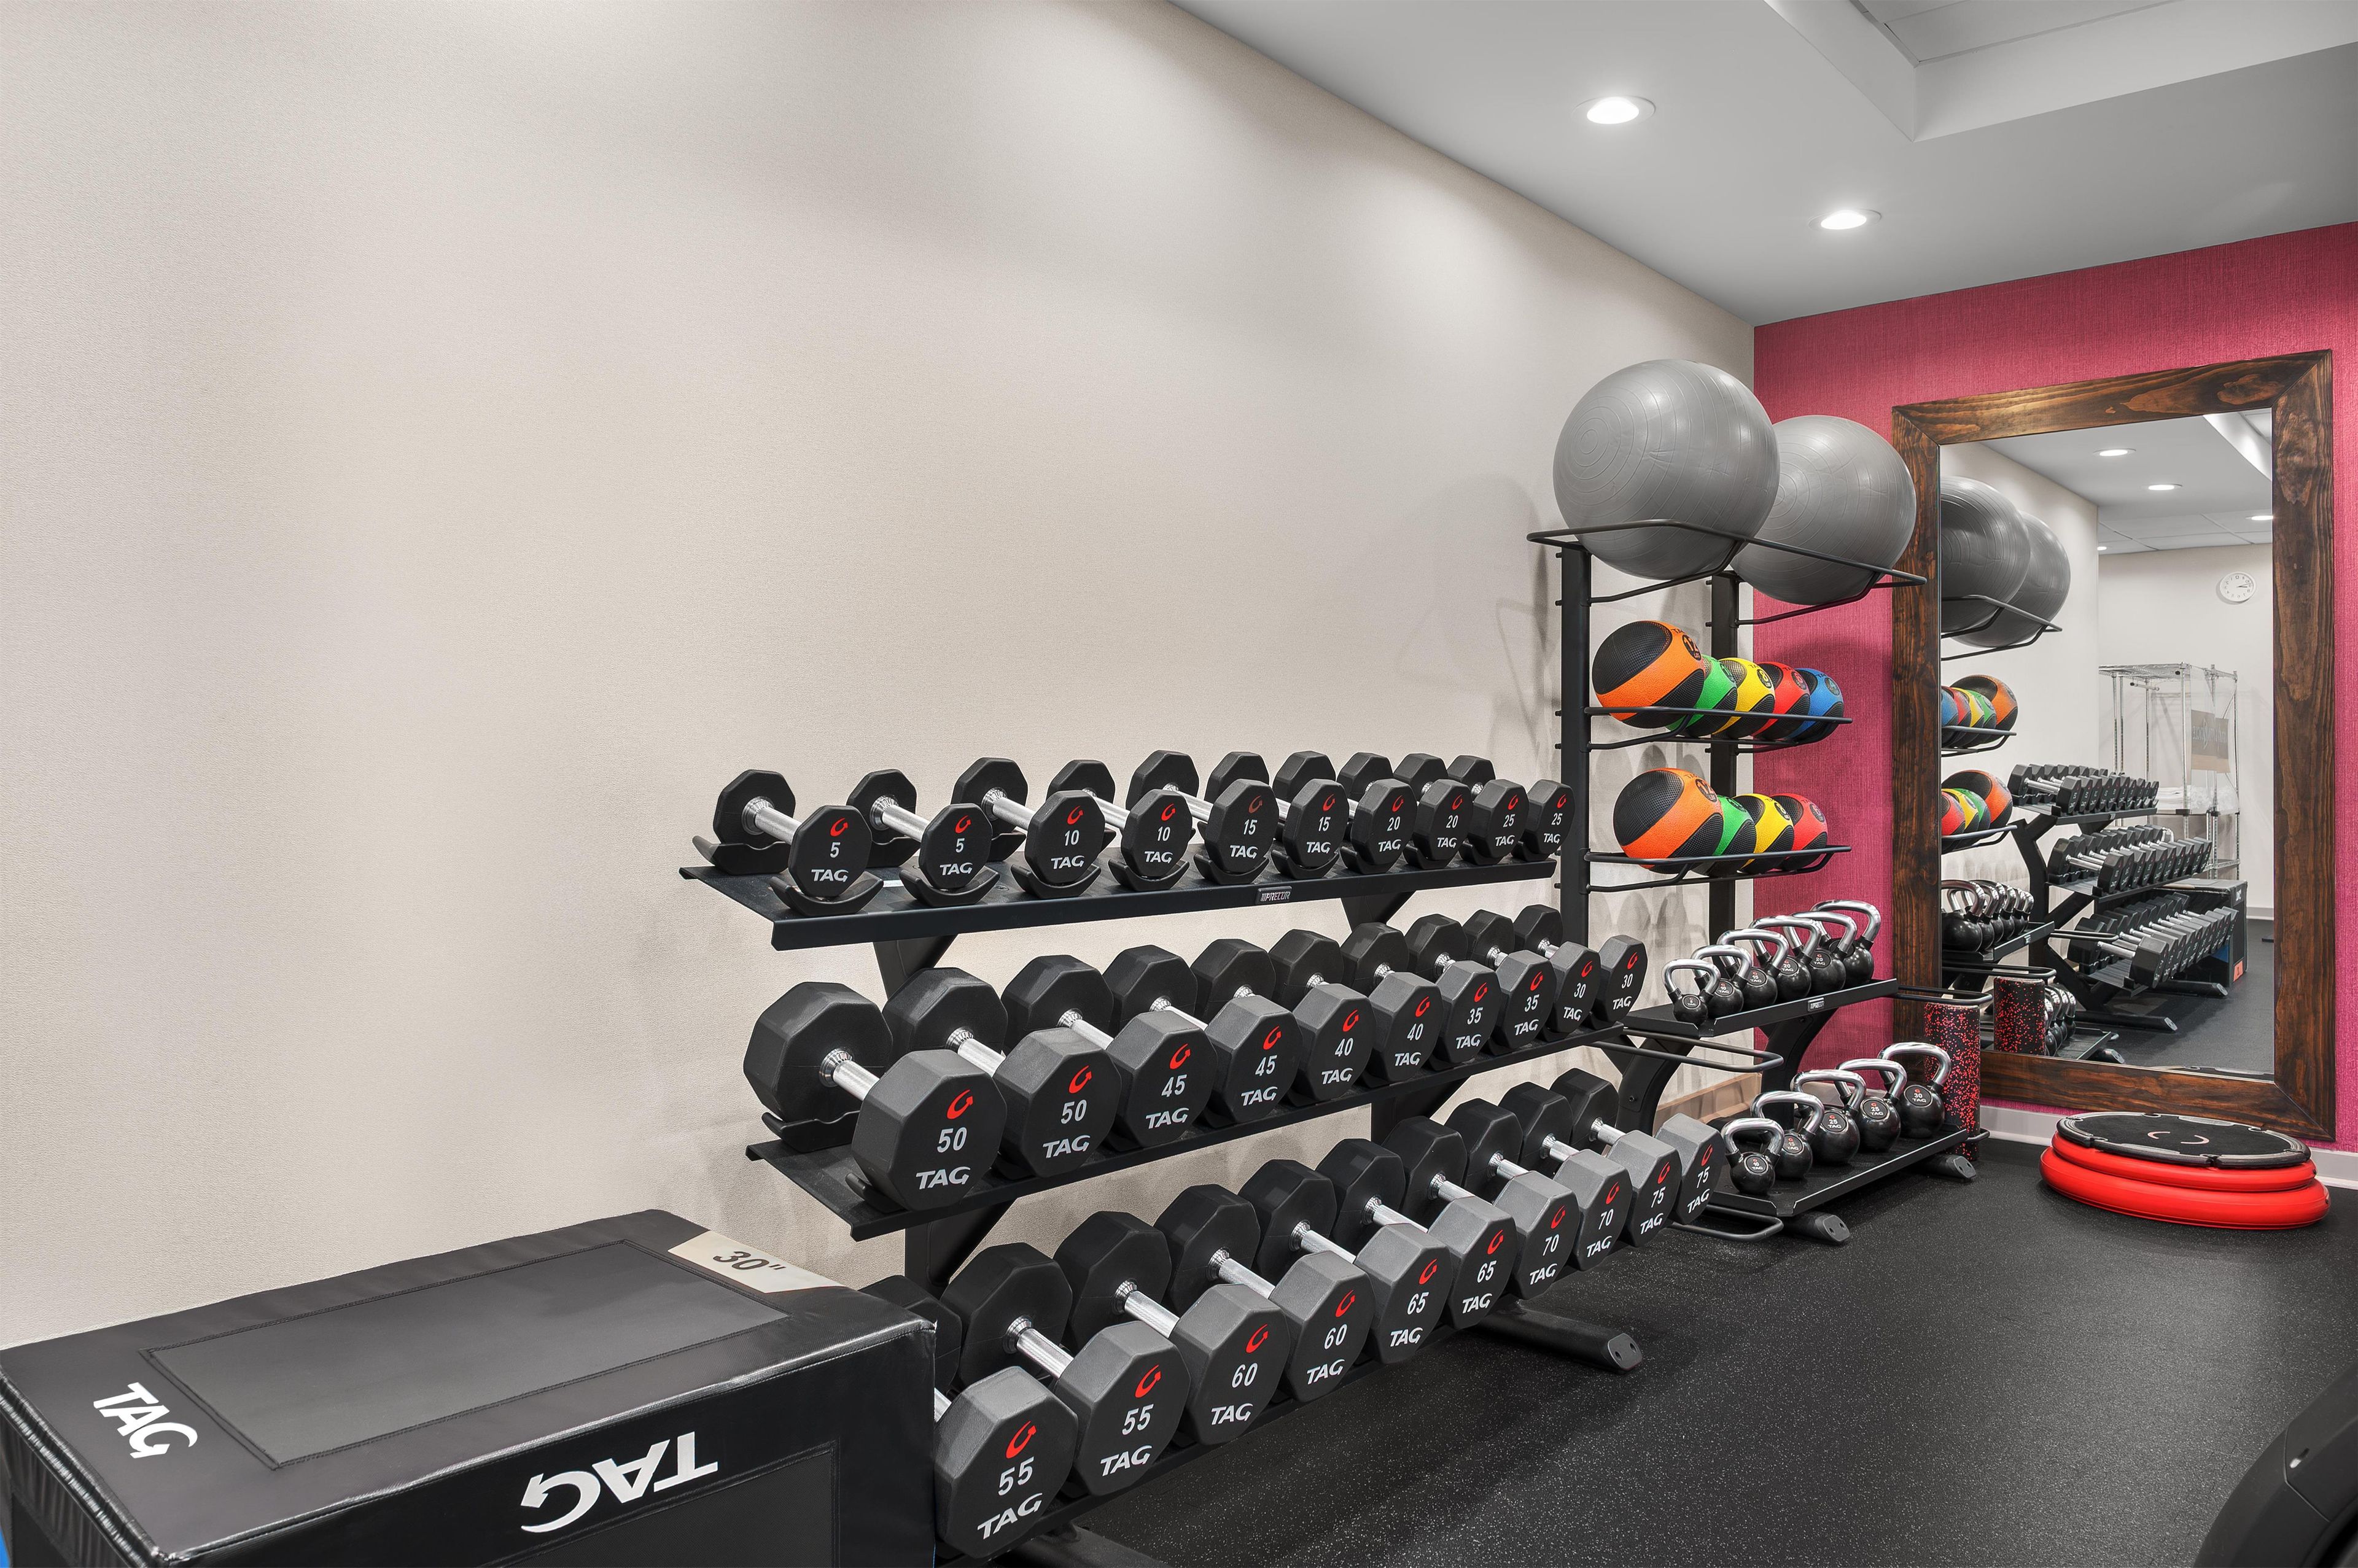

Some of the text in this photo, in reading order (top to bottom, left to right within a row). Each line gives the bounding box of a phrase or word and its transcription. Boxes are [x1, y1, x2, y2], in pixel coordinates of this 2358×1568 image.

[1760, 670, 1769, 682] 8
[1243, 819, 1258, 835] 15
[1318, 817, 1331, 831] 15
[1387, 816, 1401, 831] 20
[1446, 815, 1458, 828] 20
[1503, 813, 1516, 828] 25
[1551, 812, 1563, 826] 25
[1065, 829, 1080, 846] 10
[1158, 826, 1170, 842] 10
[1437, 837, 1457, 848] TAG
[1495, 834, 1515, 847] TAG
[1544, 833, 1561, 844] TAG
[830, 842, 841, 858] 5
[955, 837, 965, 853] 5
[1229, 845, 1258, 859] TAG
[1306, 841, 1331, 854] TAG
[1378, 839, 1401, 852] TAG
[1051, 855, 1084, 869] TAG
[1144, 851, 1173, 864] TAG
[811, 869, 849, 882] TAG
[940, 862, 973, 875] TAG
[1574, 982, 1586, 998] 30
[1621, 973, 1633, 989] 30
[1524, 994, 1539, 1012] 35
[1612, 995, 1633, 1010] TAG
[1467, 1007, 1484, 1025] 35
[1563, 1006, 1582, 1022] TAG
[1407, 1023, 1423, 1041] 40
[1514, 1019, 1539, 1036] TAG
[1334, 1038, 1353, 1057] 40
[1456, 1034, 1482, 1049] TAG
[1255, 1055, 1277, 1076] 45
[1395, 1052, 1422, 1066] TAG
[1321, 1068, 1353, 1085] TAG
[1161, 1074, 1188, 1098] 45
[1241, 1086, 1278, 1106] TAG
[1060, 1099, 1087, 1124] 50
[1145, 1108, 1189, 1129] TAG
[937, 1127, 967, 1153] 50
[1043, 1135, 1091, 1159] TAG
[916, 1166, 971, 1190] TAG
[1697, 1166, 1710, 1189] 75
[1651, 1186, 1666, 1208] 75
[1687, 1188, 1710, 1214] TAG
[1598, 1208, 1614, 1230] 70
[1640, 1213, 1663, 1235] TAG
[1543, 1234, 1560, 1256] 70
[1586, 1235, 1612, 1257] TAG
[712, 1251, 787, 1270] 30"
[1477, 1260, 1497, 1283] 65
[1530, 1263, 1557, 1285] TAG
[1407, 1292, 1430, 1315] 65
[1462, 1293, 1493, 1314] TAG
[1324, 1324, 1347, 1349] 60
[1390, 1327, 1423, 1347] TAG
[1232, 1362, 1258, 1388] 60
[1307, 1359, 1345, 1385] TAG
[93, 1382, 198, 1459] TAG
[1122, 1403, 1154, 1435] 55
[1211, 1403, 1253, 1425] TAG
[1100, 1445, 1152, 1477] TAG
[520, 1431, 719, 1534] TAG
[998, 1456, 1035, 1496] 55
[977, 1492, 1043, 1540] TAG
